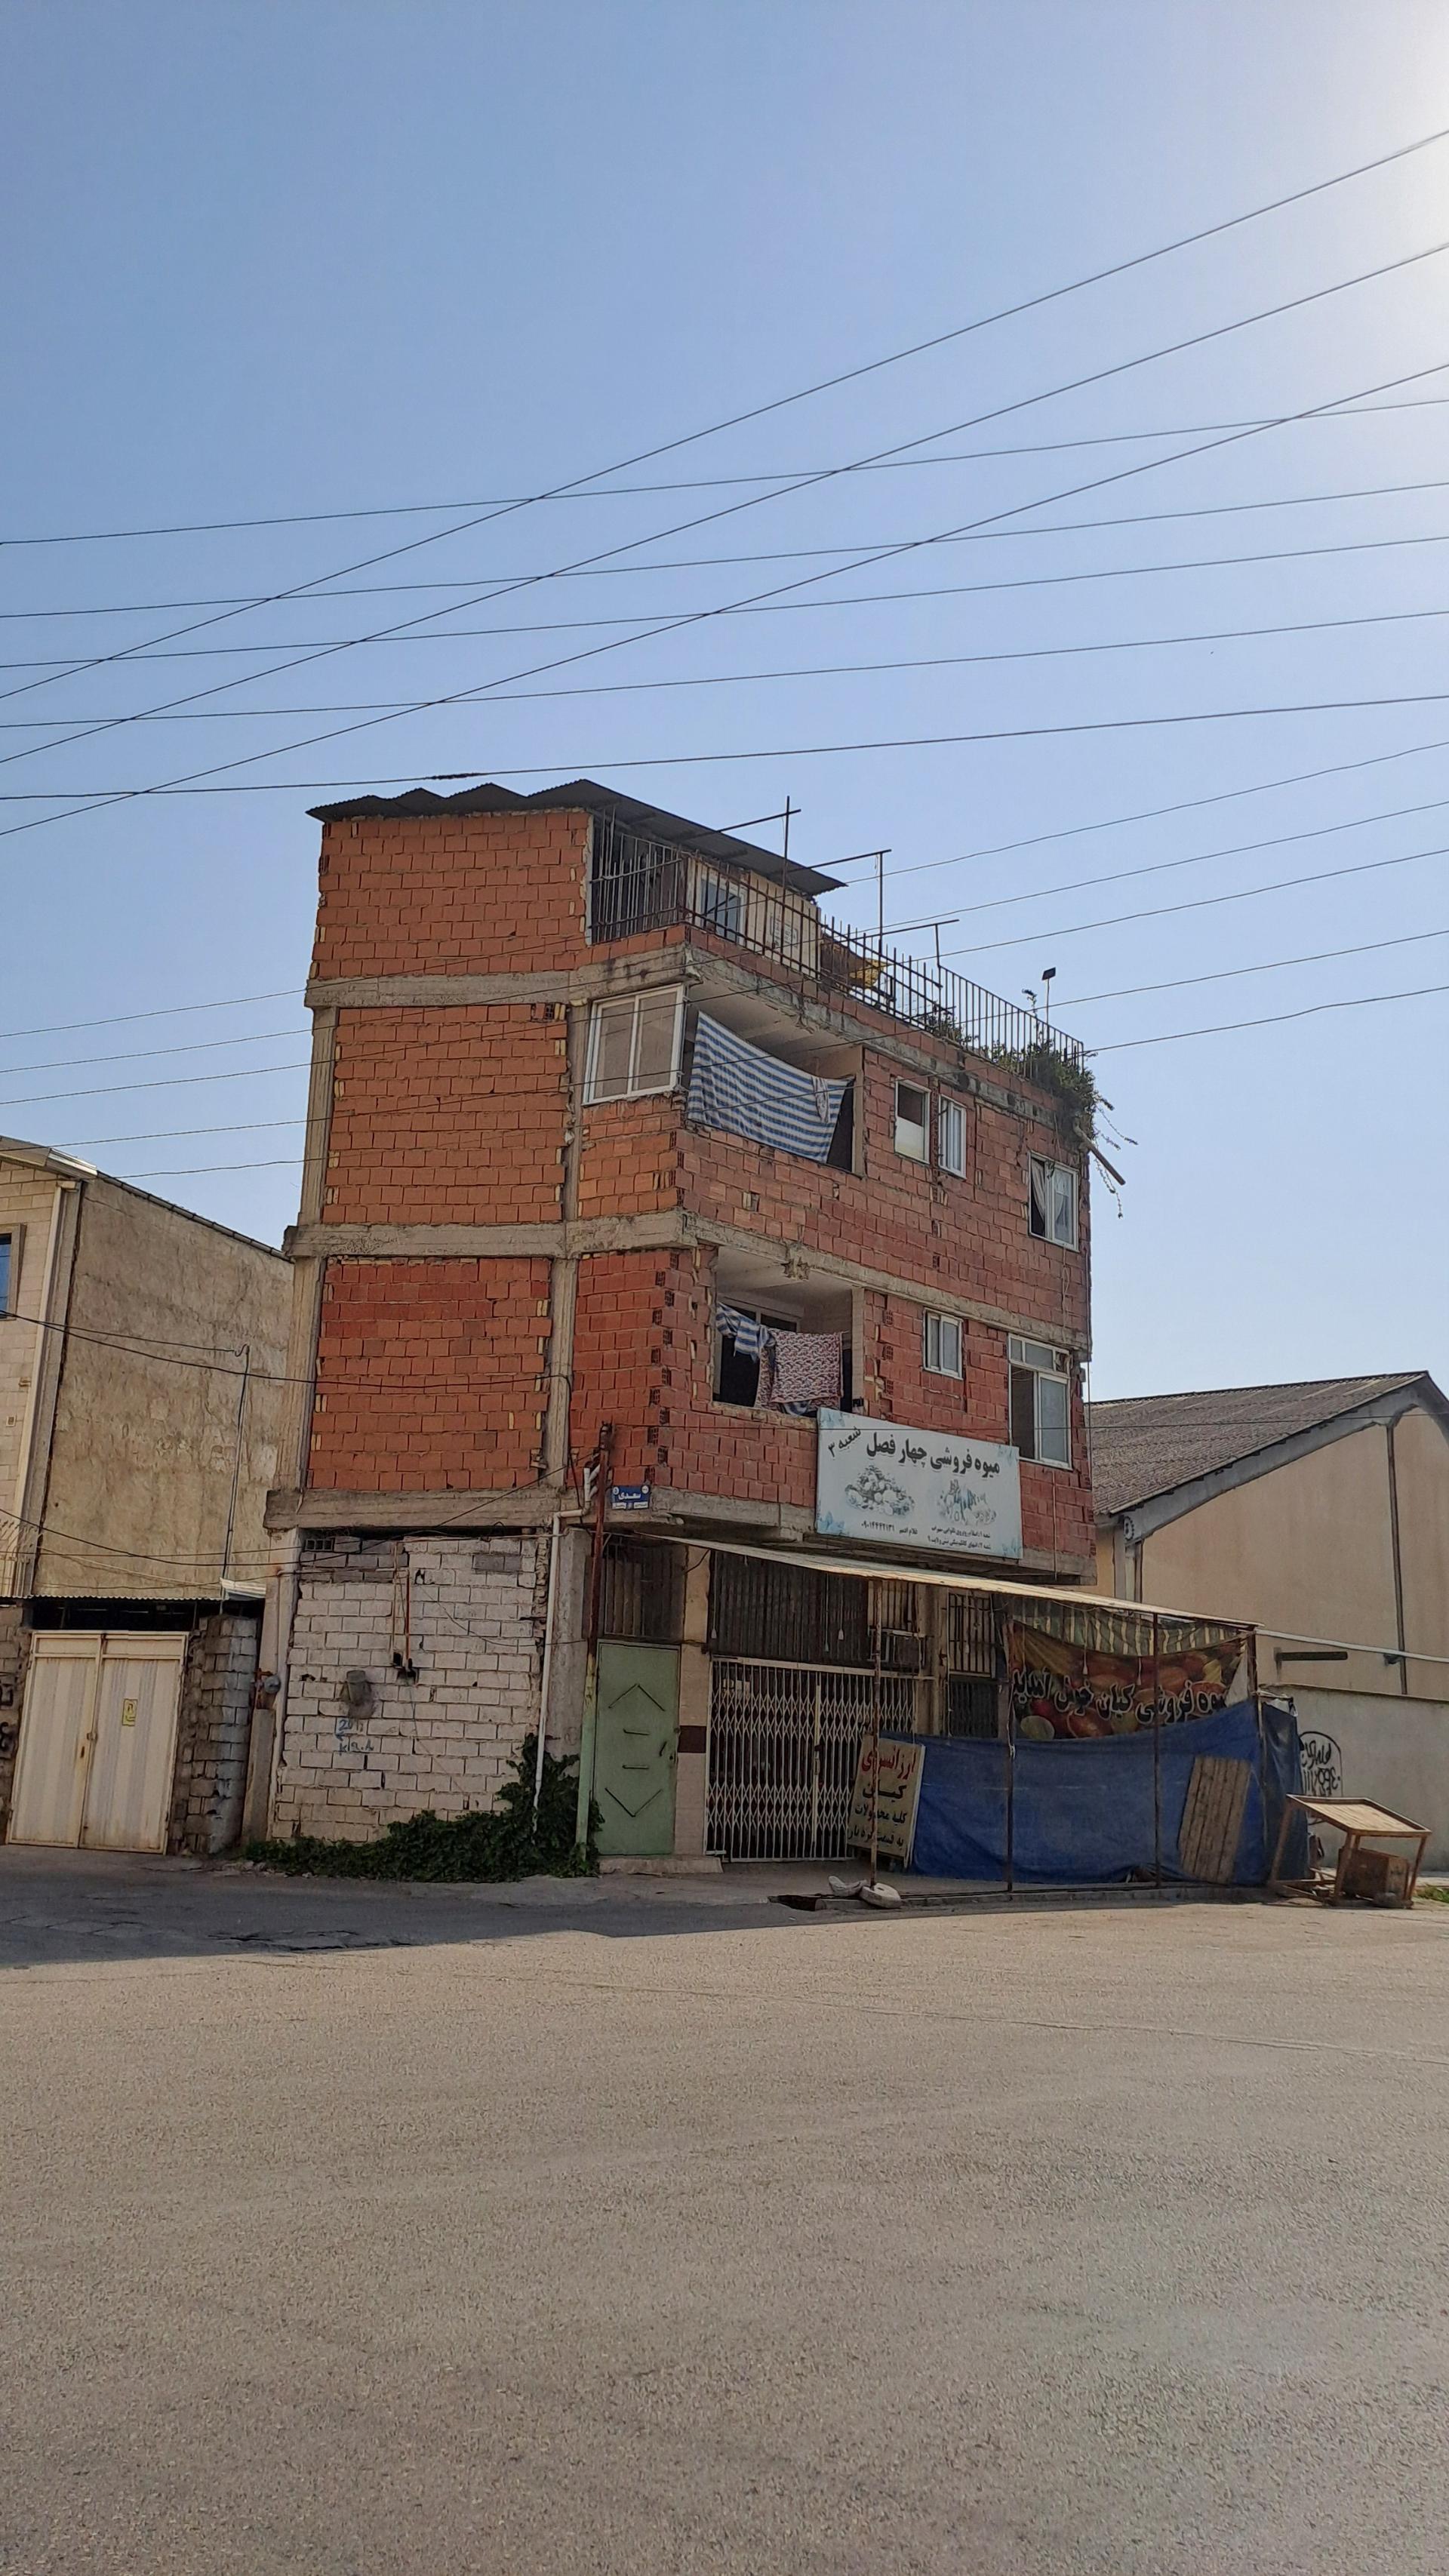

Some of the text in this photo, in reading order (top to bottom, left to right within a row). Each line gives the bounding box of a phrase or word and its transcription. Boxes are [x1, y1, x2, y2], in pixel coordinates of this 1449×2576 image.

[838, 1426, 861, 1449] شعبه
[866, 1432, 1000, 1477] میوه فروشی چهار فصل
[618, 1491, 641, 1500] سعدی
[1096, 1683, 1135, 1722] کیان
[863, 1779, 907, 1802] کیان
